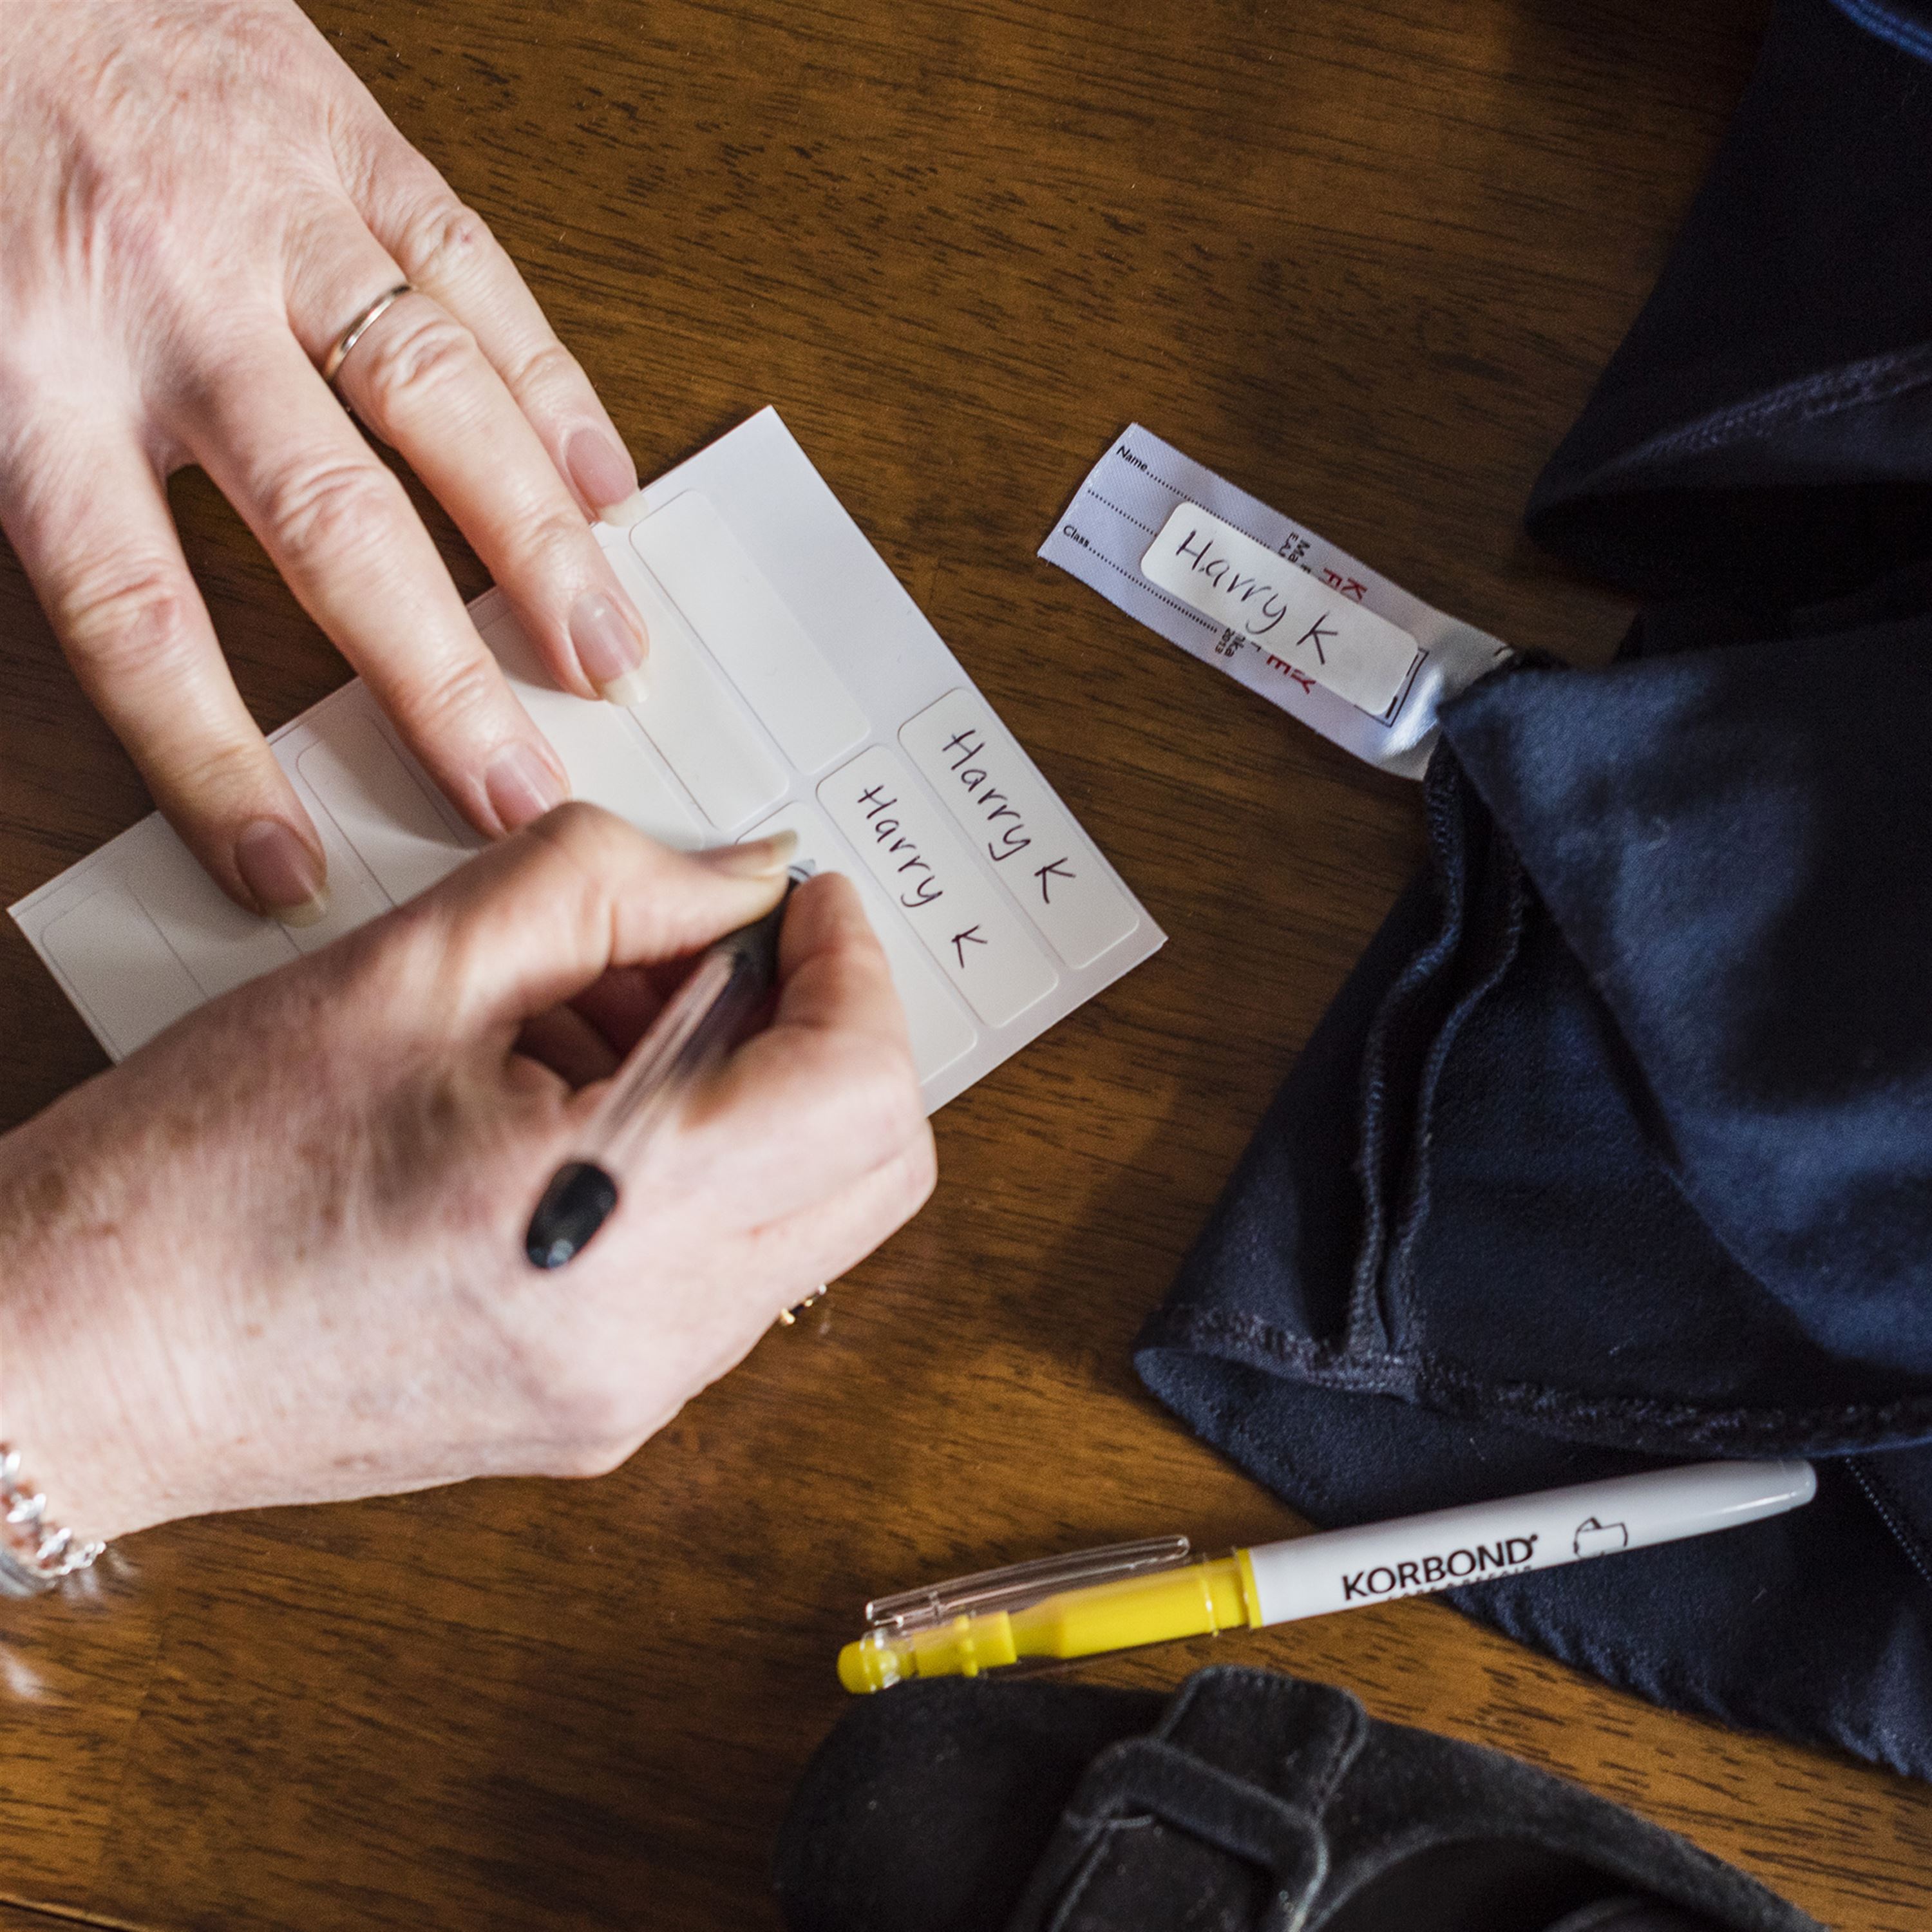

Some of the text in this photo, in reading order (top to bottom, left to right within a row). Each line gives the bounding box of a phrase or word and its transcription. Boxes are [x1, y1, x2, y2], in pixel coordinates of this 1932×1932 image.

[1116, 445, 1148, 472] Name
[1063, 524, 1090, 548] Class
[1177, 529, 1338, 665] Harry K
[942, 729, 1075, 904] Harry K
[858, 785, 987, 968] Harry K
[1342, 1534, 1539, 1600] KORBOND
